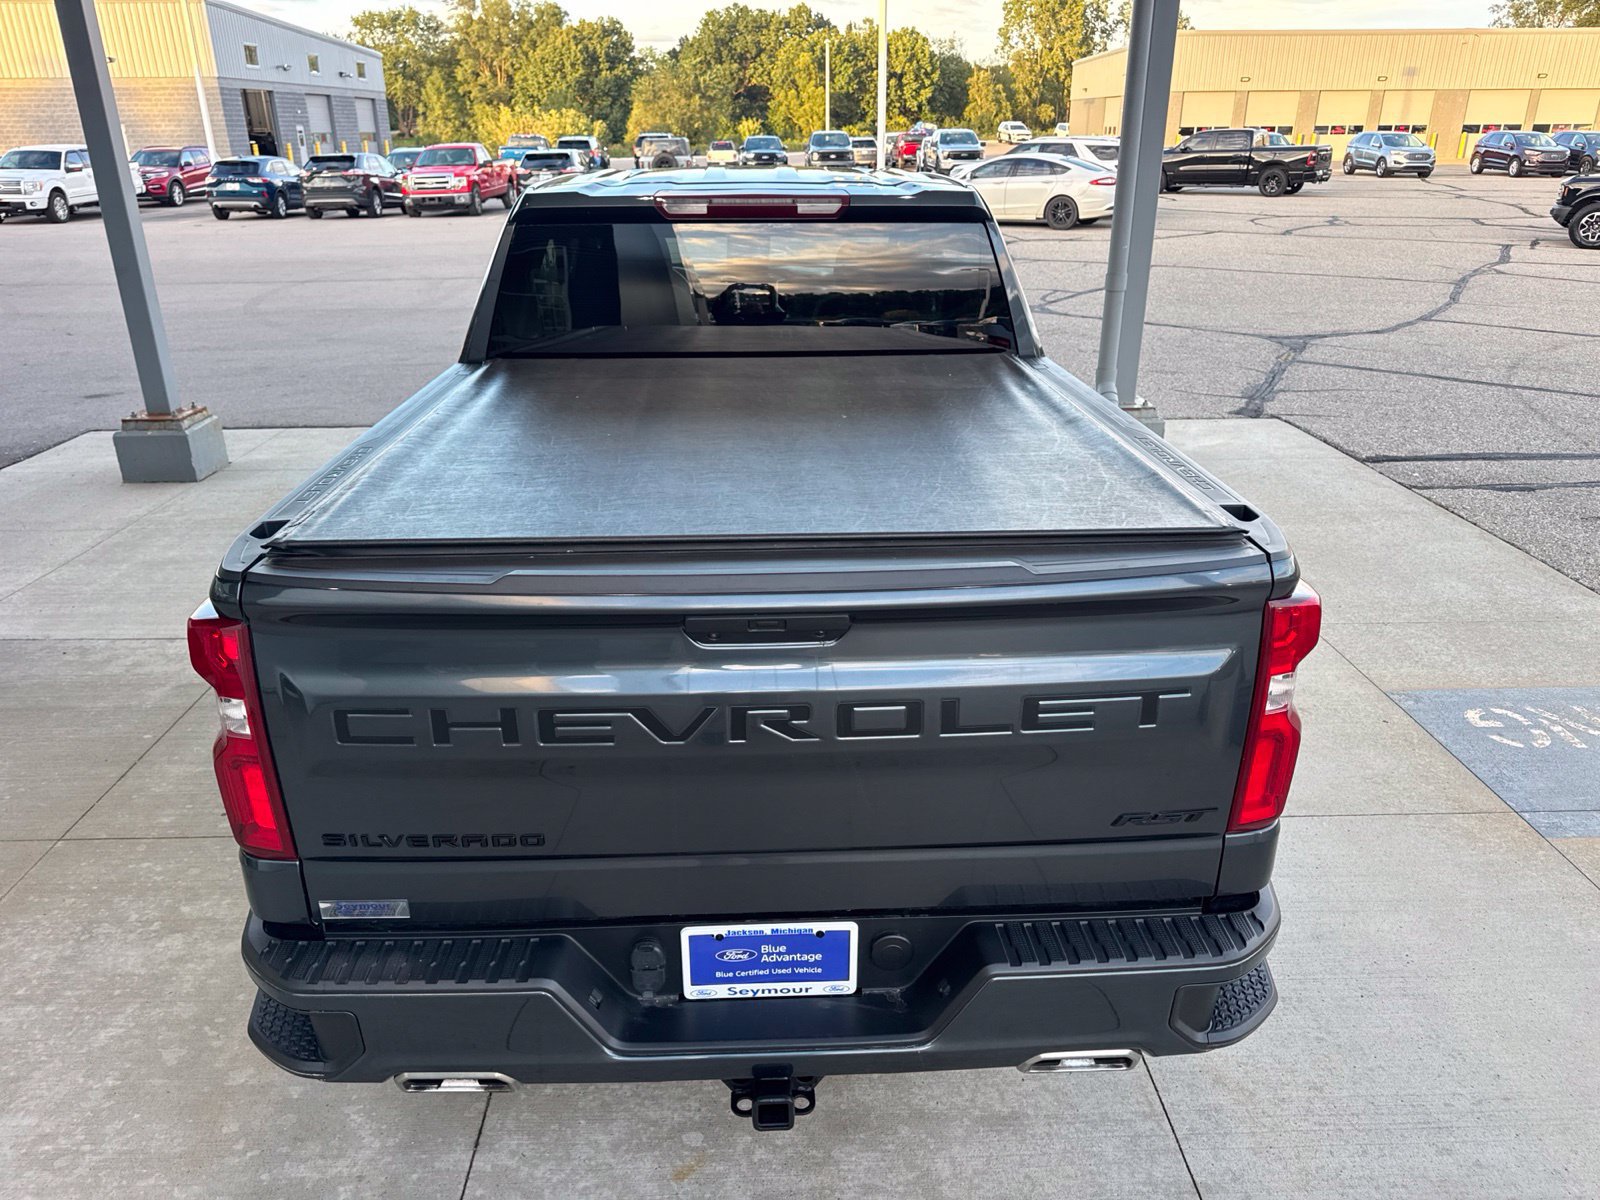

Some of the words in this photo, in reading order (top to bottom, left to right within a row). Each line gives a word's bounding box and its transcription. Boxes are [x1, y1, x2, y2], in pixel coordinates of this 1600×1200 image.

[332, 688, 1192, 747] CHEVROLET
[1110, 807, 1219, 827] RST
[321, 833, 546, 849] SILVERADO
[760, 944, 787, 953] Blue
[722, 949, 751, 961] Ford
[760, 952, 823, 963] Advantage
[735, 968, 769, 977] Certified
[771, 967, 792, 975] Used
[793, 966, 823, 974] Vehicle
[694, 989, 714, 998] Ford
[727, 985, 813, 997] Seymour
[826, 985, 847, 993] Ford
